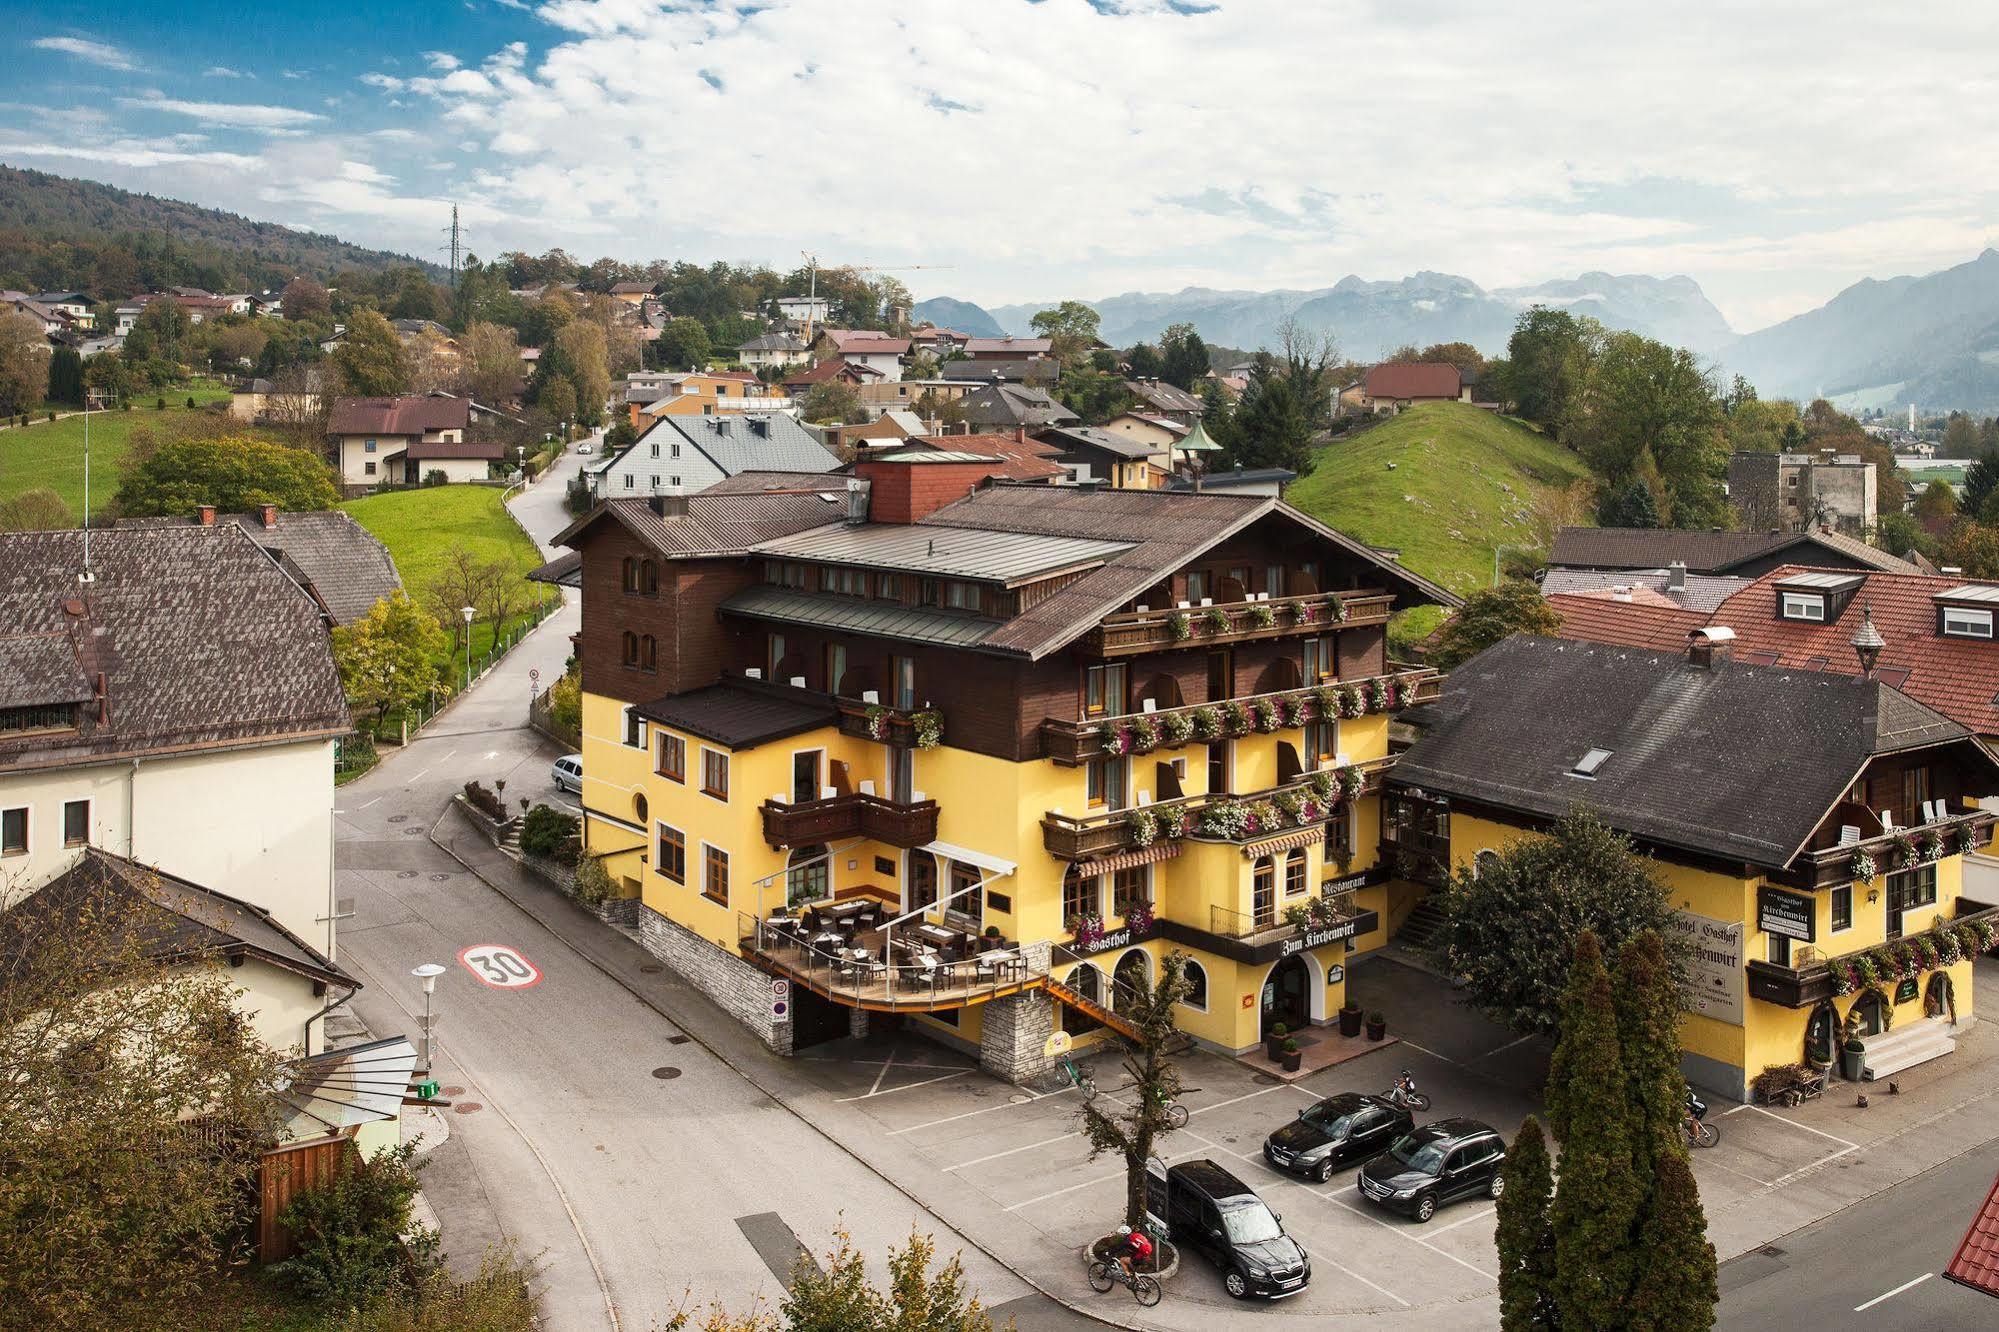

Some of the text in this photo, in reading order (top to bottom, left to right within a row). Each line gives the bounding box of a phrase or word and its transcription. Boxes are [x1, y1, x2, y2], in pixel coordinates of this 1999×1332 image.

[1323, 876, 1365, 894] Restaurant
[1762, 904, 1808, 922] Kirchenwirt
[1281, 922, 1355, 957] Zum Kirchenwirt
[1703, 923, 1738, 947] Gasthof
[470, 952, 532, 983] 30
